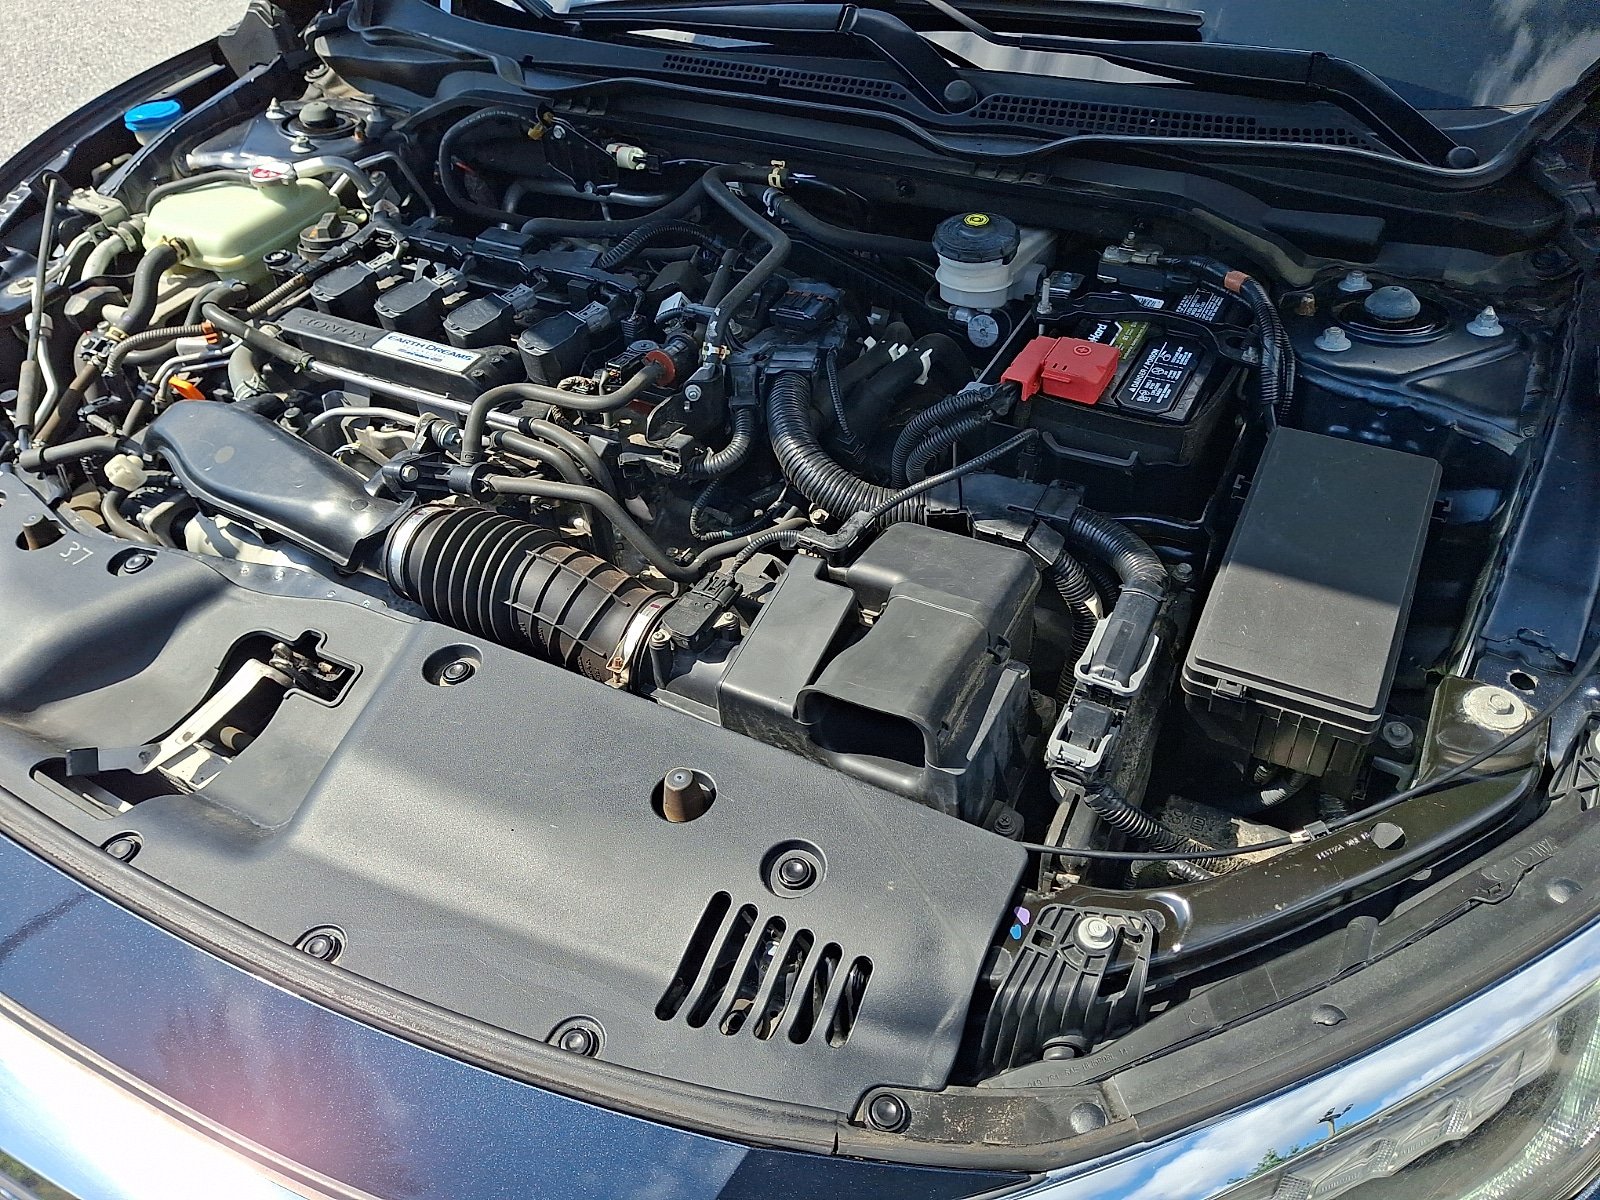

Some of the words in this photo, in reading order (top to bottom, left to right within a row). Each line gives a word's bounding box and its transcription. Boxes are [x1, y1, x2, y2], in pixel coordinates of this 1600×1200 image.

[388, 335, 426, 350] EARTH
[425, 344, 474, 361] DREAMS
[1131, 367, 1148, 388] DANGER
[1144, 348, 1160, 367] POISON
